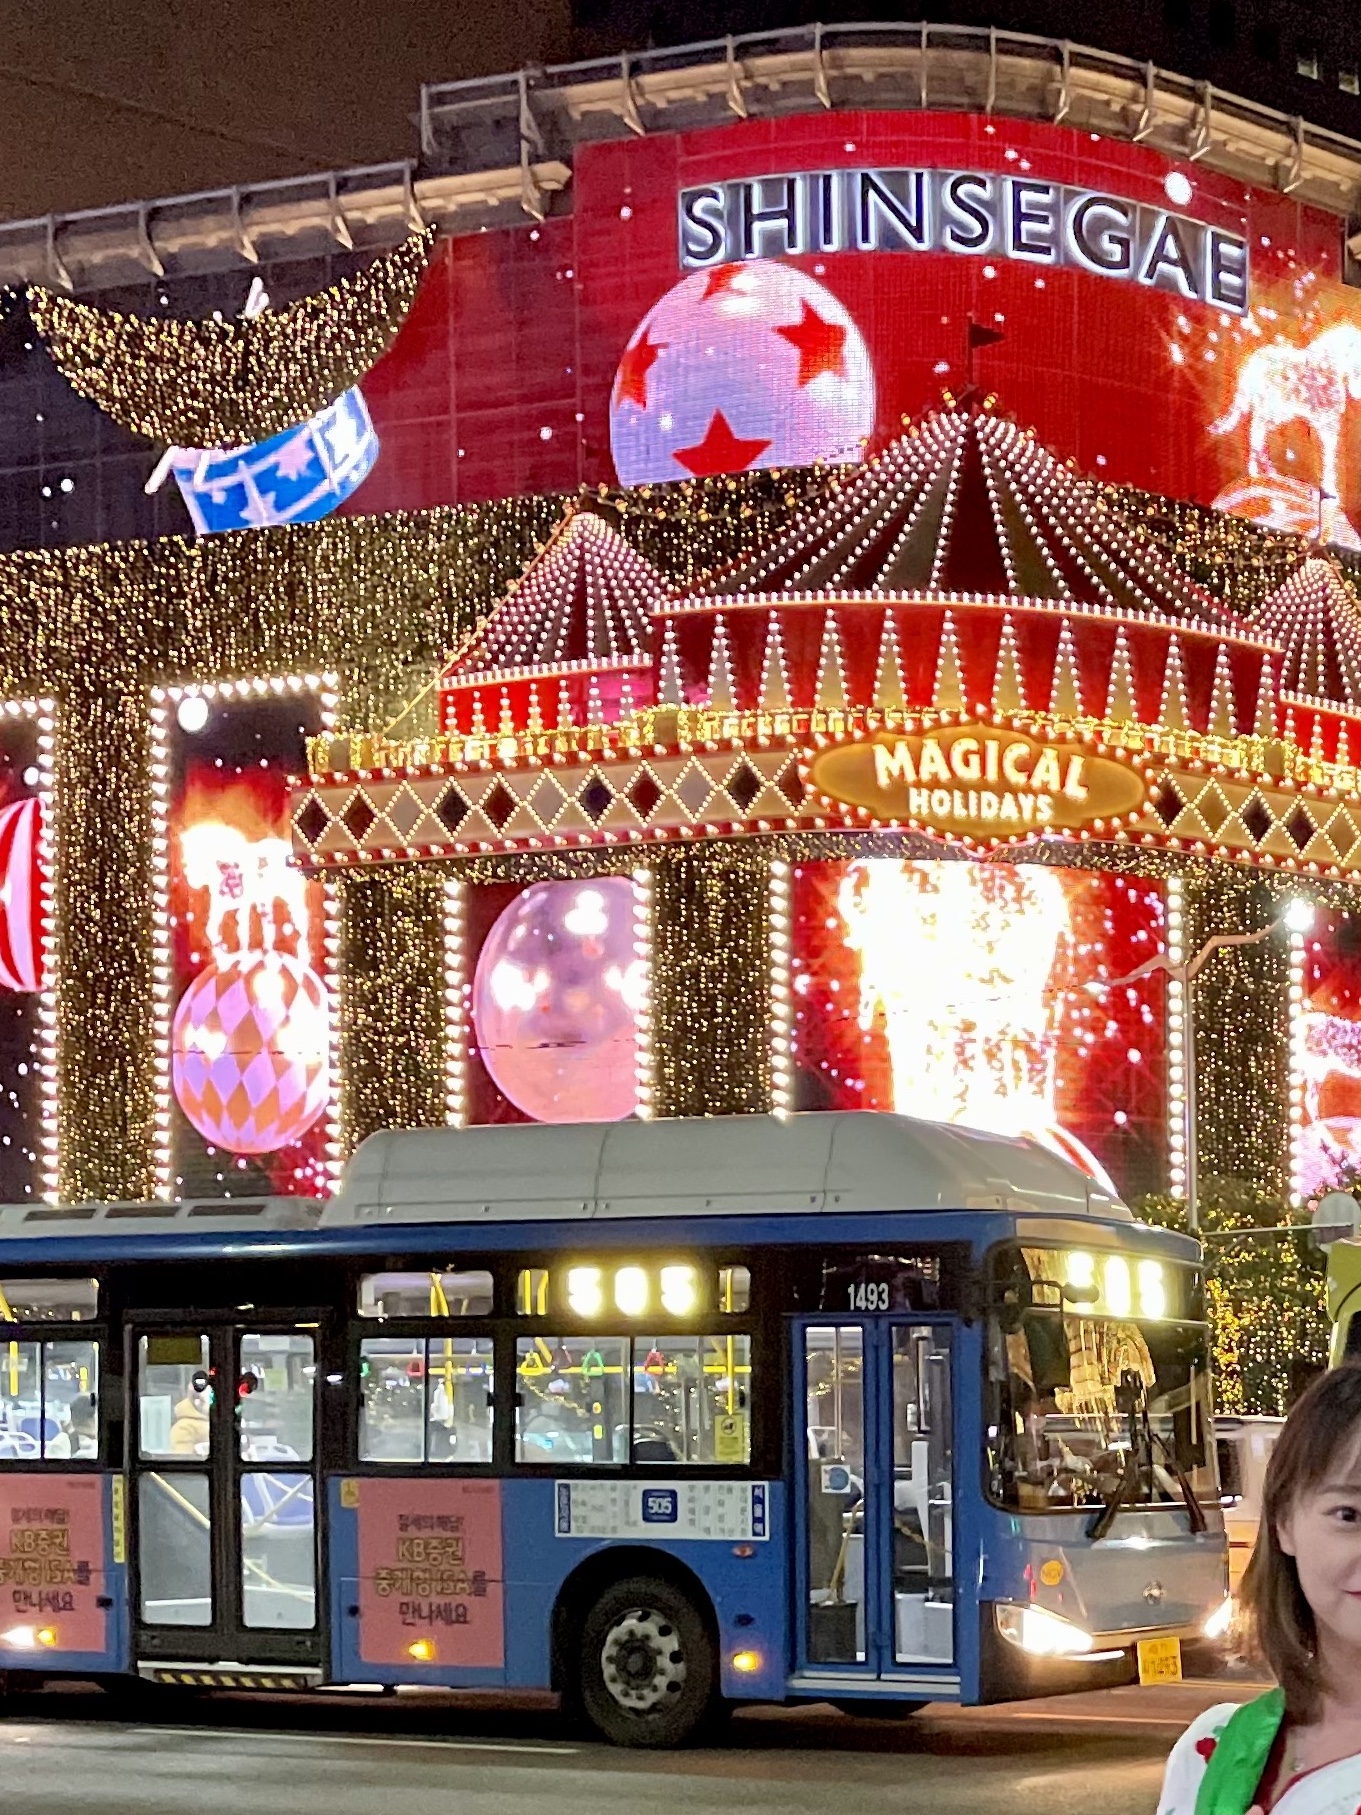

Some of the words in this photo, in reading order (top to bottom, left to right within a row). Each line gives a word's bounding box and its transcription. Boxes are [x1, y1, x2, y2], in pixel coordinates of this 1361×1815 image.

[682, 169, 1247, 314] SHINSEGAE
[871, 737, 1089, 800] MAGICAL
[908, 787, 1054, 821] HOLIDAYS
[566, 1266, 696, 1316] 505
[848, 1283, 889, 1311] 1493
[647, 1497, 673, 1514] 505
[398, 1537, 463, 1566] KB증권
[12, 1590, 74, 1613] 만나세요
[399, 1602, 470, 1626] 만나세요
